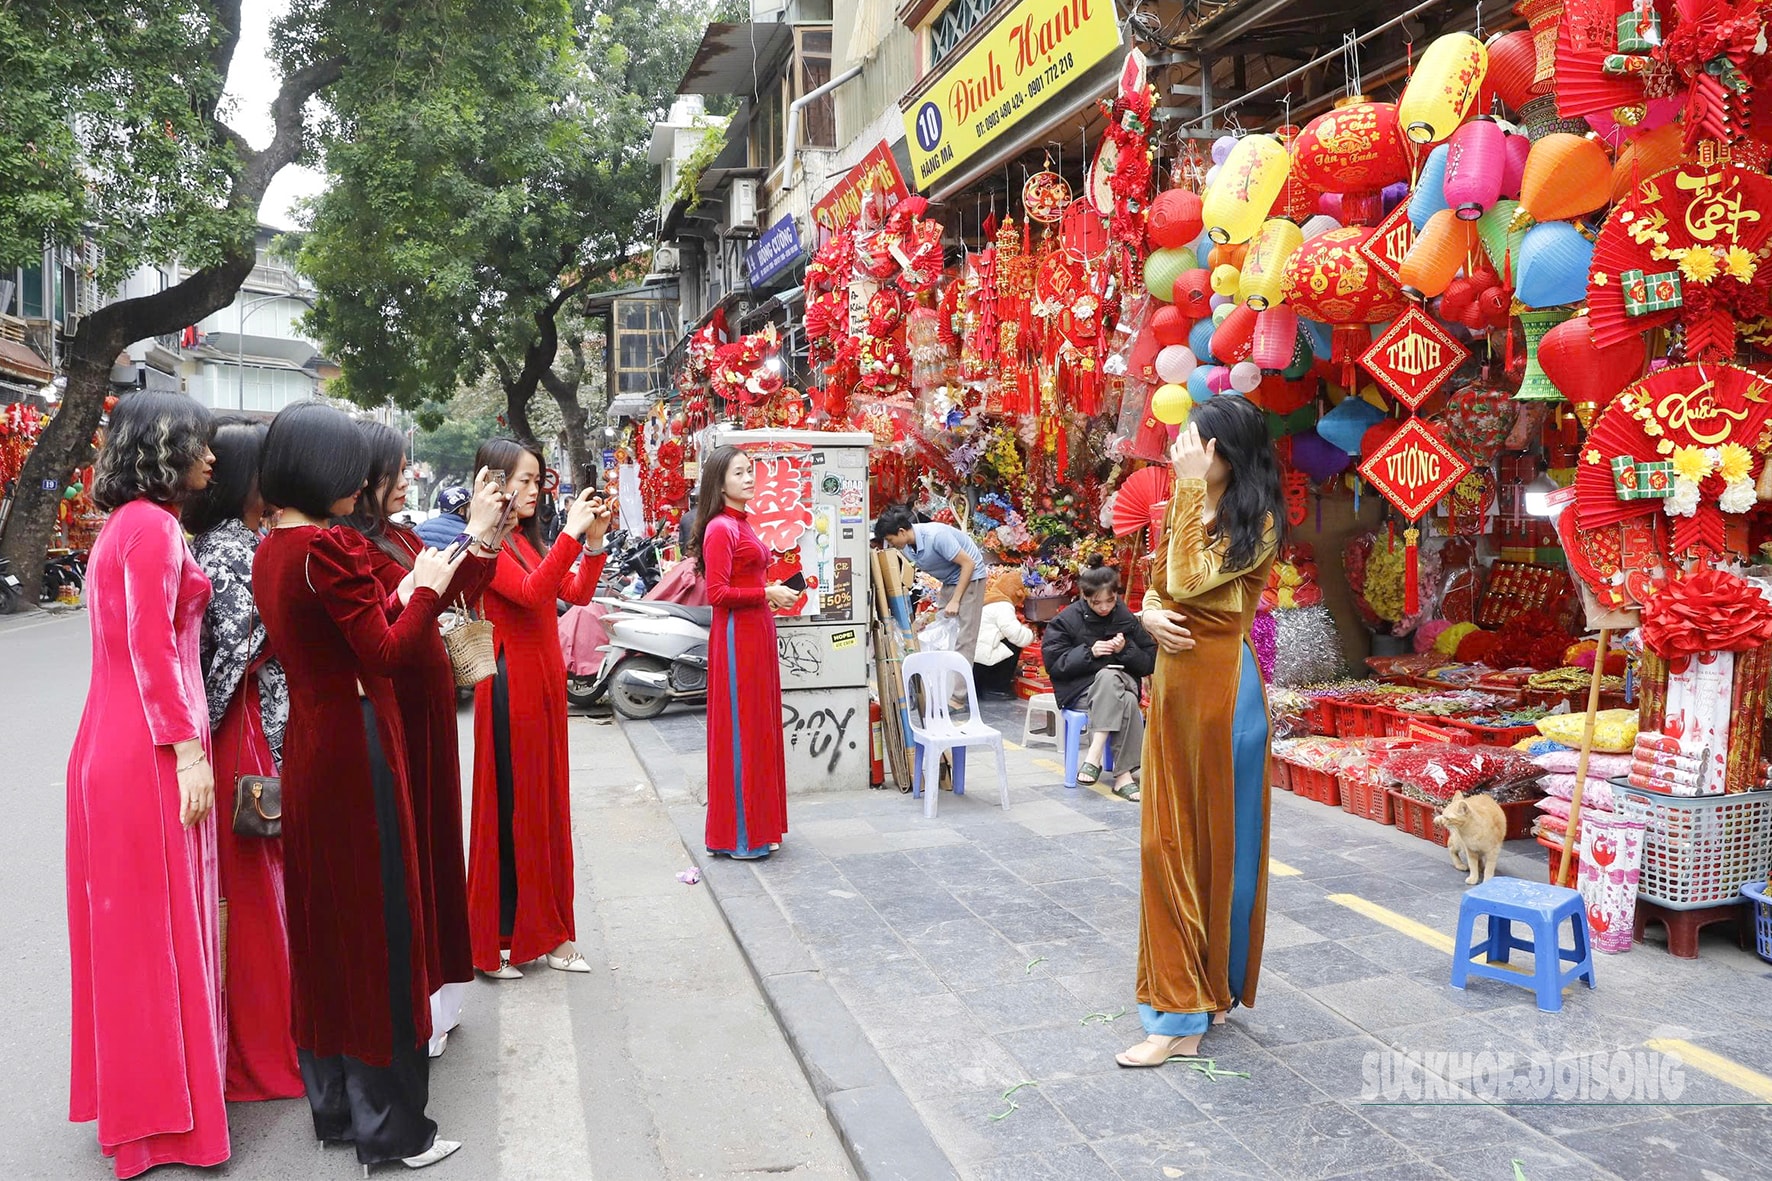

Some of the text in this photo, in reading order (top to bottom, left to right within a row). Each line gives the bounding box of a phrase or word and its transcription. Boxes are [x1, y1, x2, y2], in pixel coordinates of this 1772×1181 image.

[984, 110, 1000, 130] 0903
[1011, 91, 1024, 110] 424
[1027, 75, 1044, 98] 0901
[1044, 63, 1059, 85] 772
[1059, 52, 1074, 75] 218
[919, 106, 939, 147] 10
[920, 141, 954, 180] HÀNG MÃ
[1675, 171, 1761, 244] Tết
[1386, 332, 1441, 387] THỊNH
[1656, 380, 1749, 444] Xuân
[1386, 441, 1440, 500] VƯỢNG
[827, 591, 852, 606] 50%
